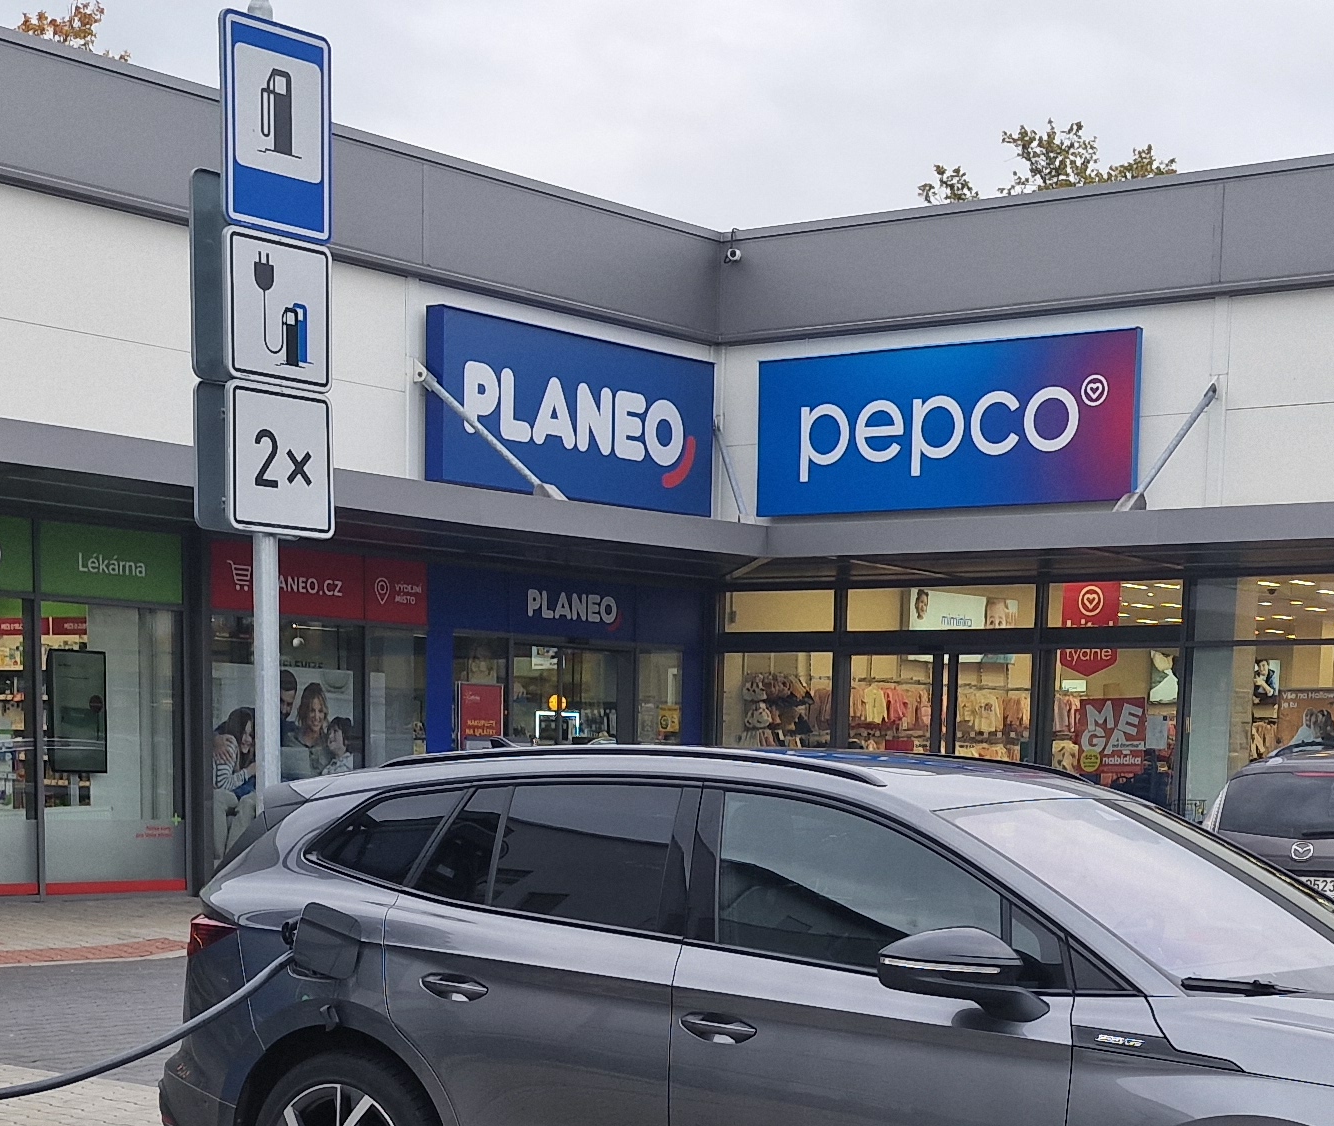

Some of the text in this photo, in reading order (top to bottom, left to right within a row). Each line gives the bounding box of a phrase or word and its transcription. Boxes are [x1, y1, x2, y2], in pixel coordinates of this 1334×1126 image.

[462, 360, 685, 467] PLANEO
[799, 386, 1080, 482] pepco
[78, 551, 146, 577] Lékárna
[279, 575, 343, 597] ANEO.CZ
[527, 588, 617, 624] PLANEO
[1102, 754, 1142, 765] nabídka
